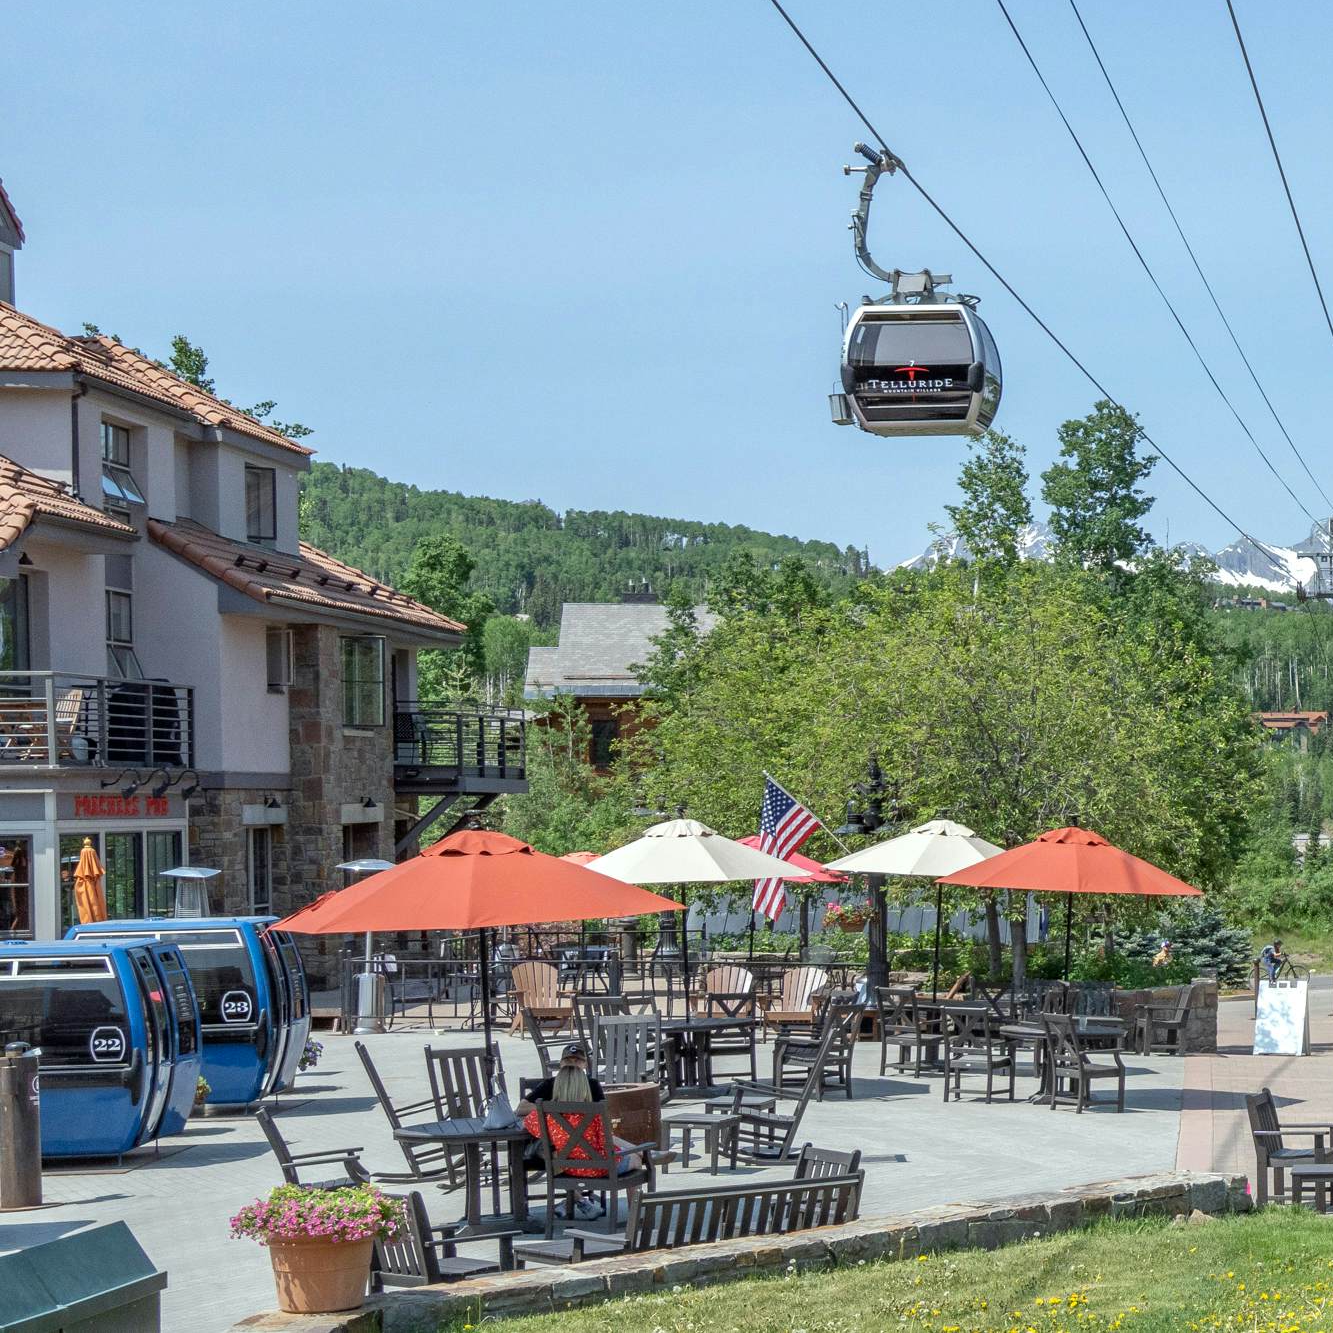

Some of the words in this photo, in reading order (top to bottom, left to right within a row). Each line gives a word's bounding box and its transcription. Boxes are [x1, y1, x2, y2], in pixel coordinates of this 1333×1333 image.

[868, 378, 953, 389] TELLURIDE
[224, 1001, 249, 1013] 23
[94, 1038, 121, 1051] 22
